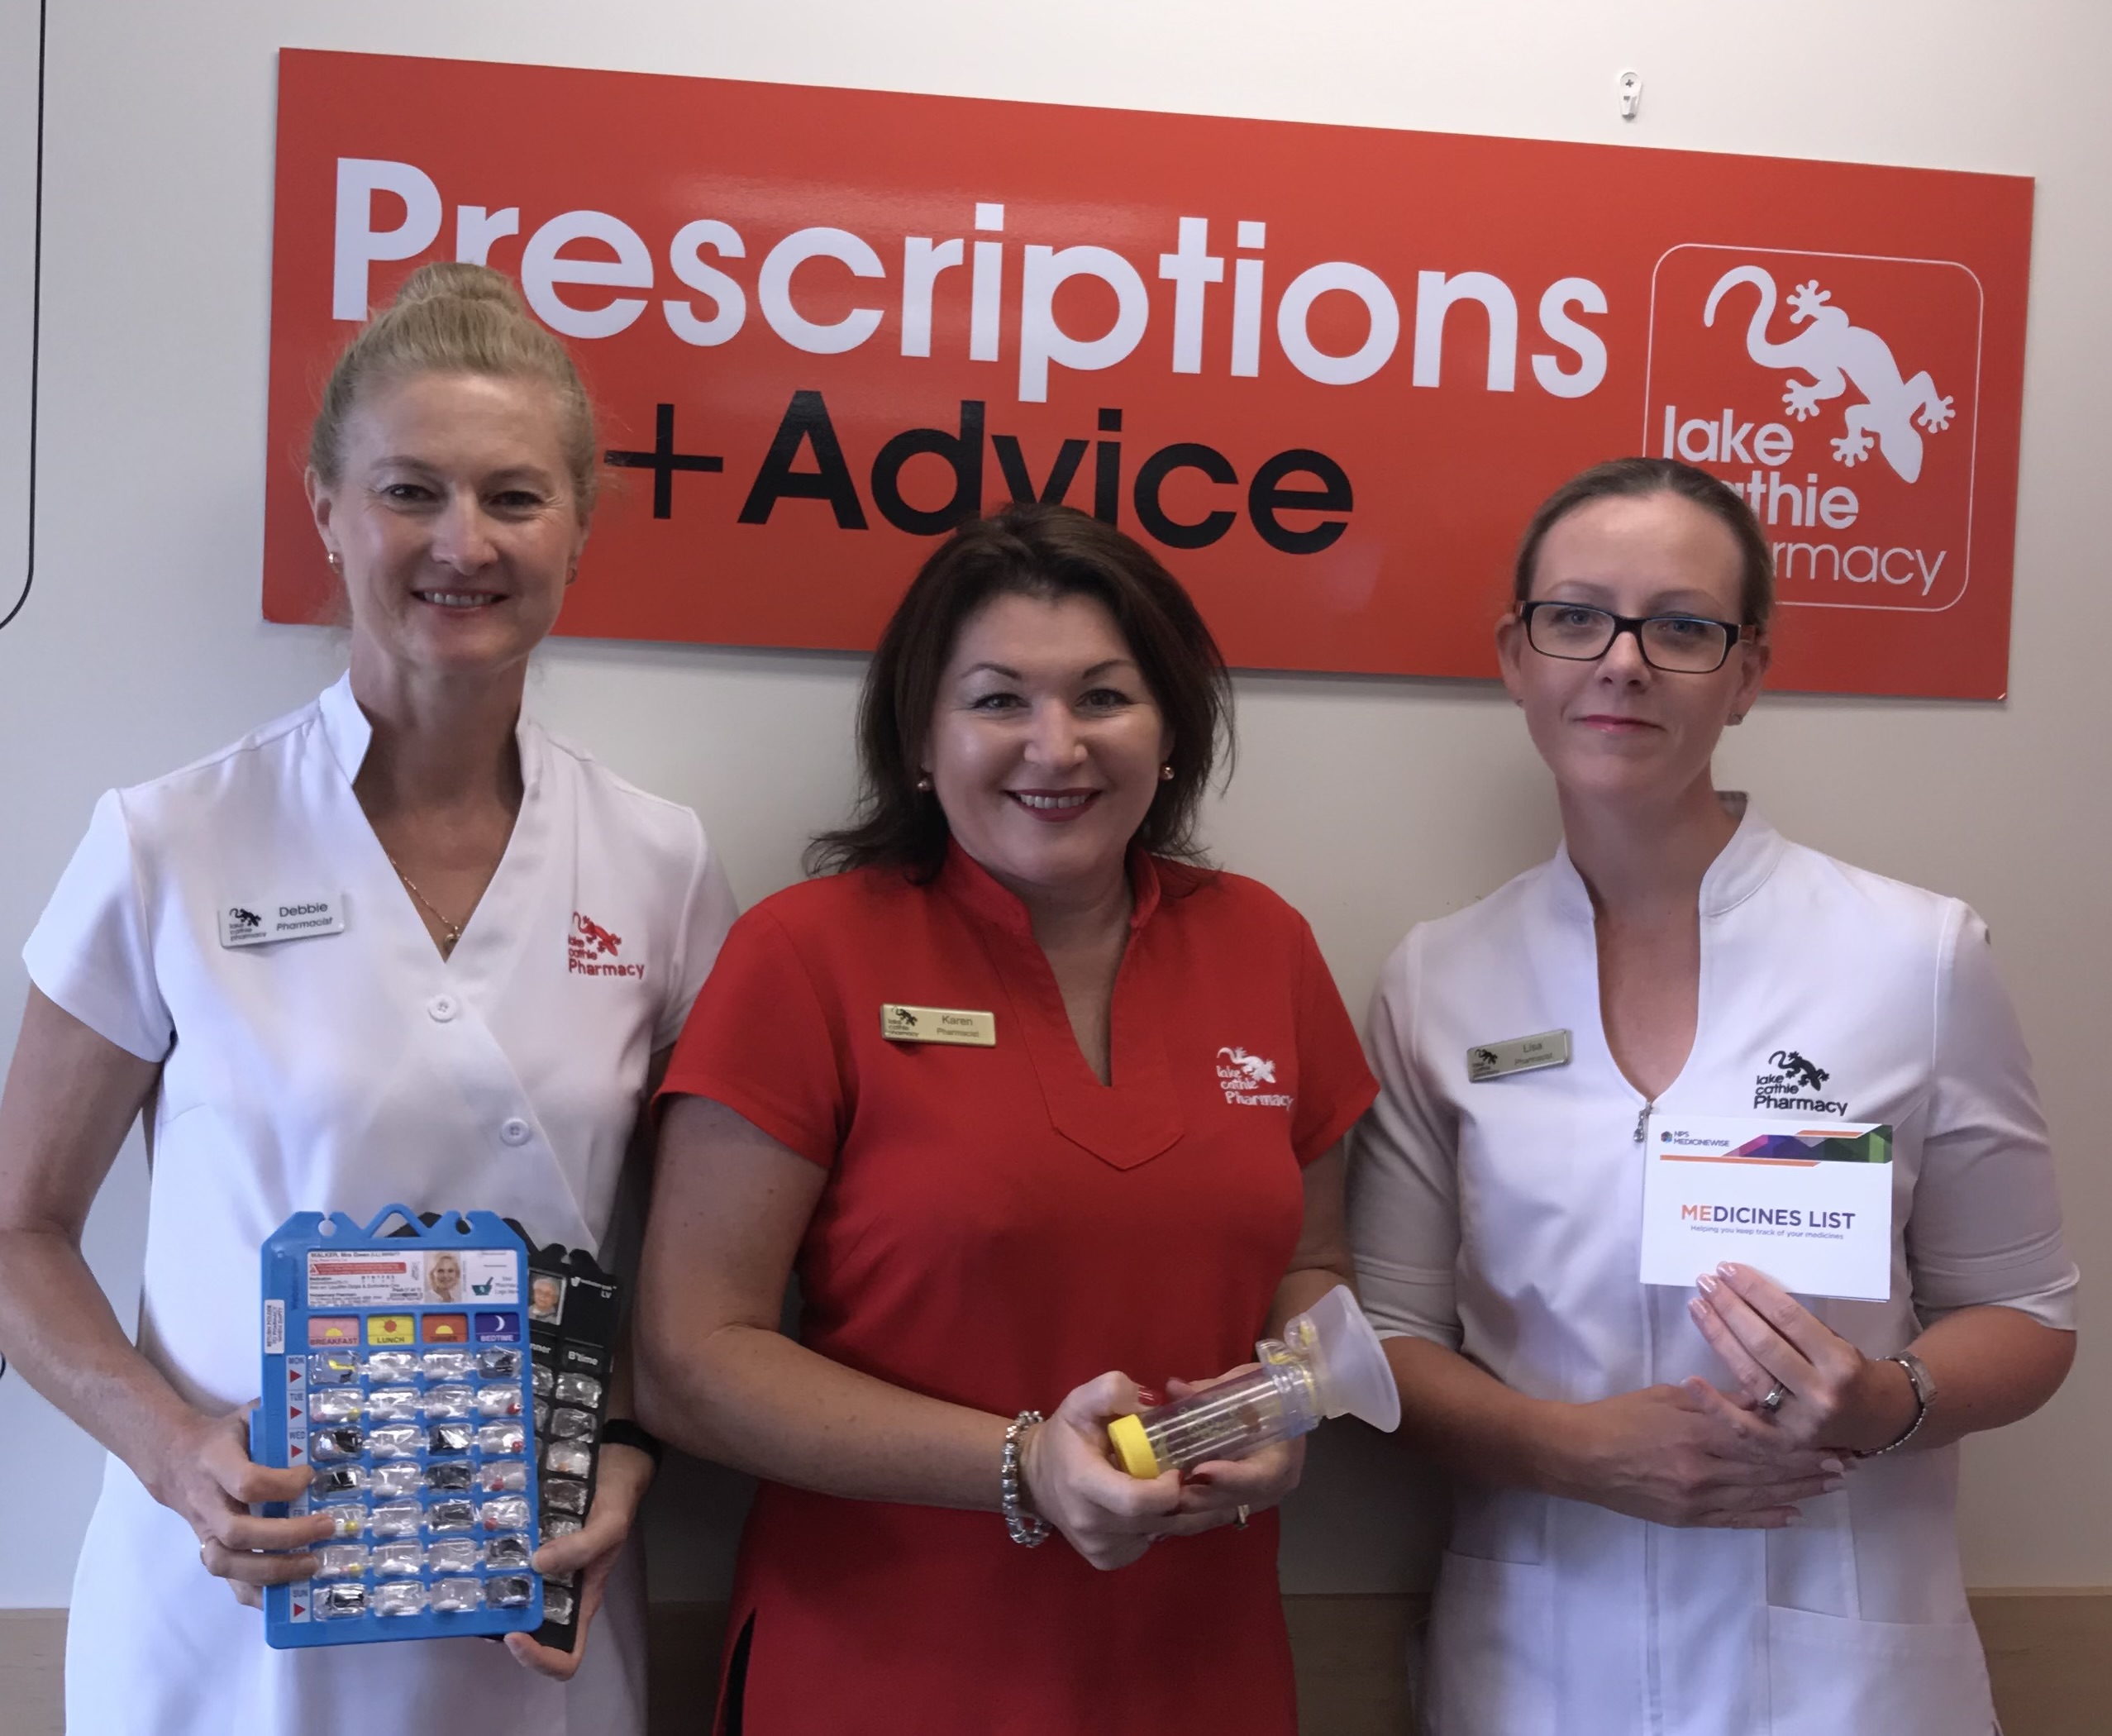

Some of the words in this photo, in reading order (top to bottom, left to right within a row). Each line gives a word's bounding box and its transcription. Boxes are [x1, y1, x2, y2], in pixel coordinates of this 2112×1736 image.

[332, 156, 1609, 403] Prescriptions
[1662, 405, 1794, 466] lake
[1722, 470, 1859, 529] thie
[1772, 541, 1947, 596] rmacy
[279, 903, 329, 918] Debbie
[276, 917, 333, 932] Pharmacist
[230, 932, 267, 942] pharmacy
[568, 958, 645, 980] Pharmacy
[942, 1015, 974, 1026] Karen
[1523, 1042, 1542, 1053] Lisa
[1216, 1065, 1242, 1078] lake
[1756, 1074, 1785, 1085] lake
[1755, 1083, 1800, 1095] cathie
[1225, 1090, 1294, 1112] Pharmacy
[1753, 1095, 1848, 1117] Pharmacy
[1673, 1138, 1730, 1147] MEDICINEWISE
[1681, 1204, 1802, 1227] MEDICINES
[1809, 1210, 1856, 1229] LIST
[1690, 1224, 1719, 1233] Helping
[1736, 1227, 1755, 1235] keep
[1804, 1231, 1844, 1240] medicines
[309, 1338, 358, 1346] BREAKFAST
[290, 1393, 304, 1401] TUE
[289, 1431, 306, 1439] WED
[293, 1589, 308, 1598] SUN
